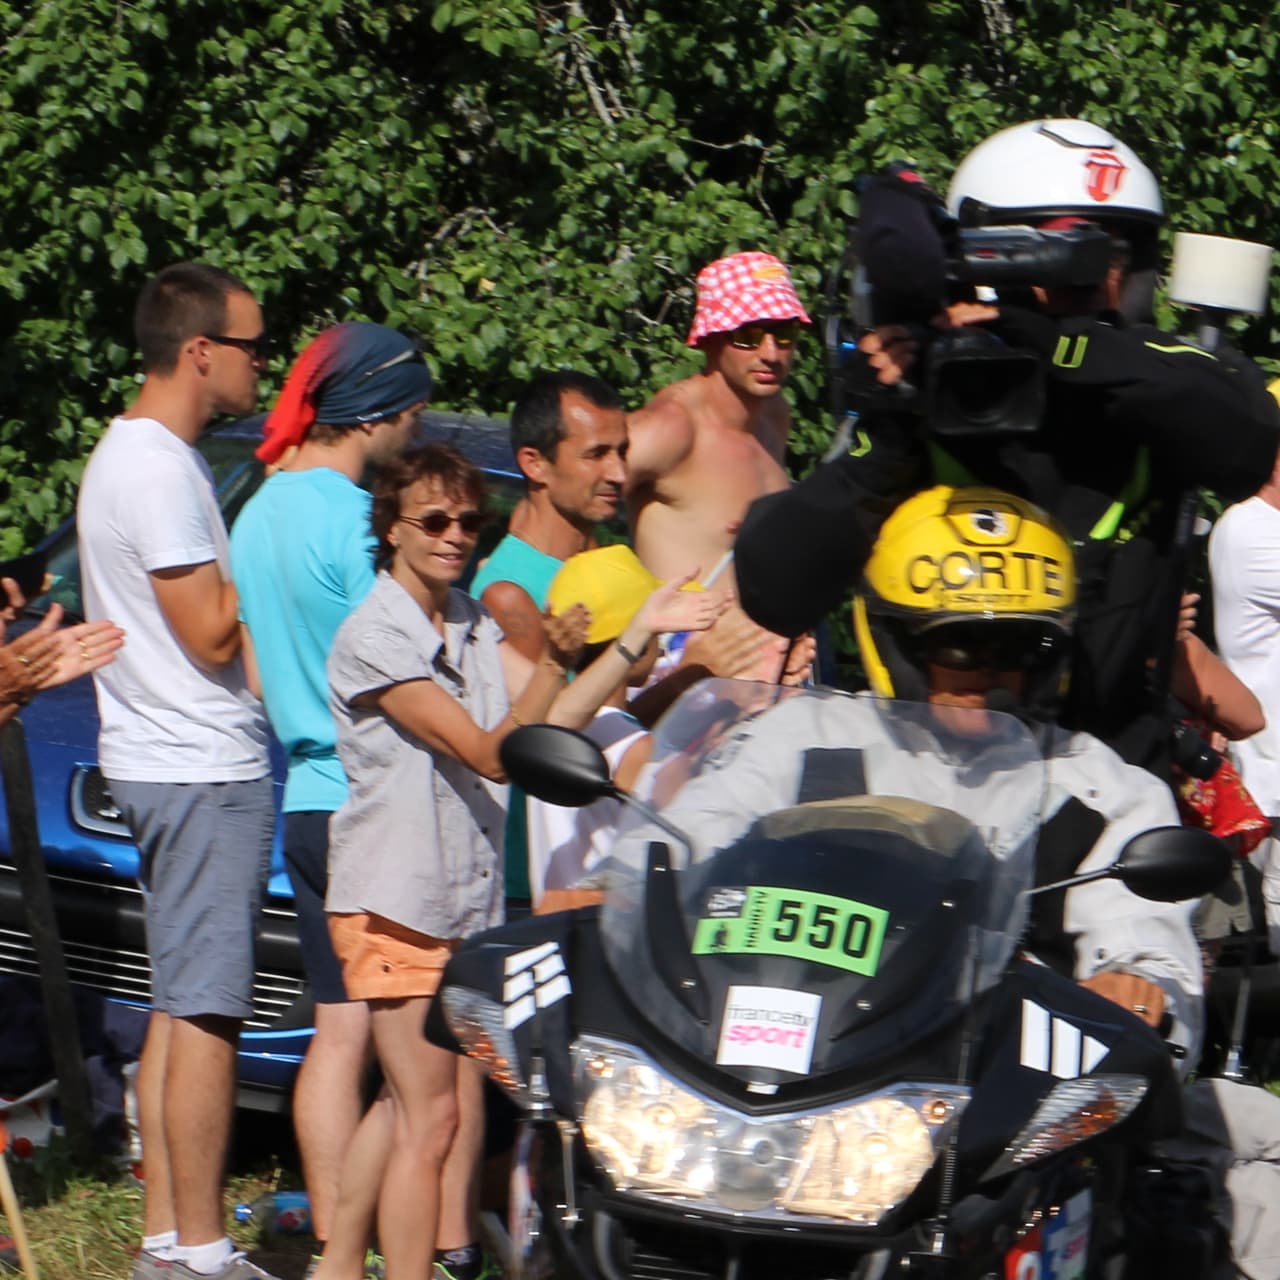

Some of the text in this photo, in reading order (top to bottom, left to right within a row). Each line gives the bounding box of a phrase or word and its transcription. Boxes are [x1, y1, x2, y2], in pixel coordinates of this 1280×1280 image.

[908, 551, 1063, 595] CORTE
[773, 899, 873, 959] 550
[726, 1024, 808, 1049] sport
